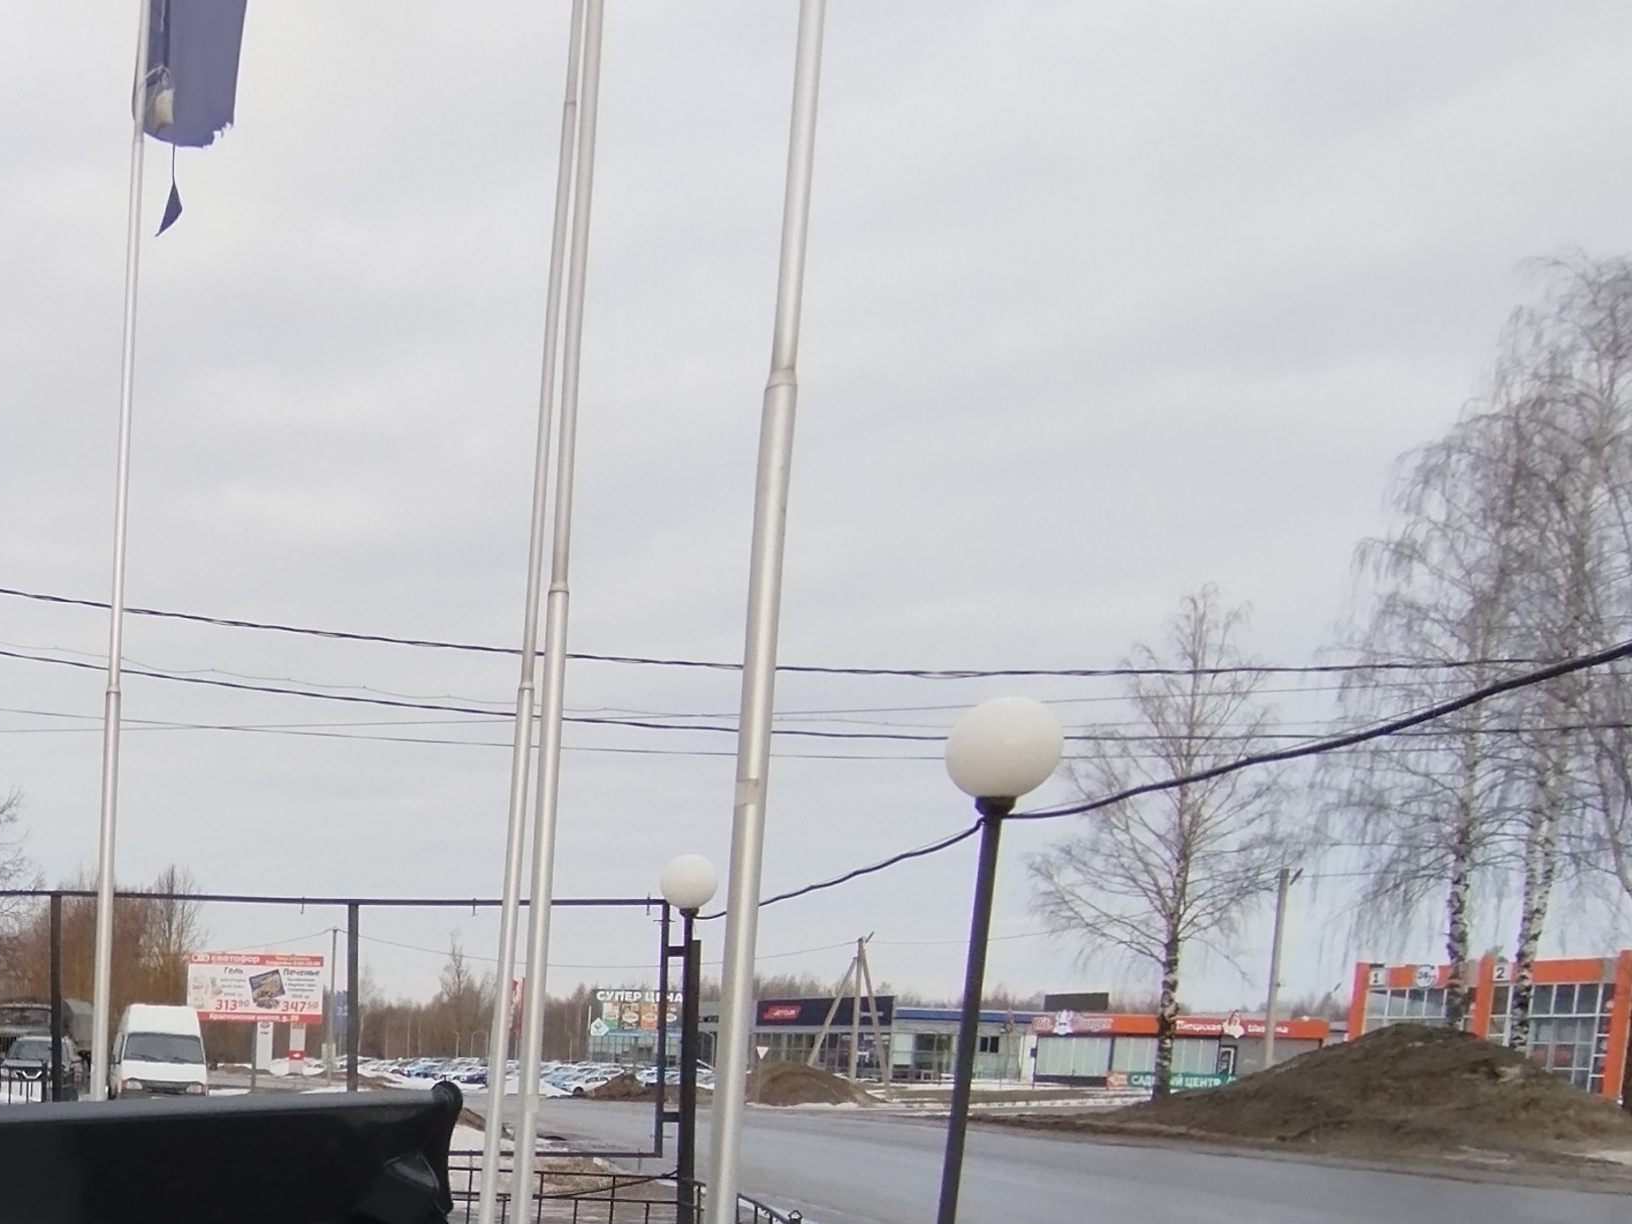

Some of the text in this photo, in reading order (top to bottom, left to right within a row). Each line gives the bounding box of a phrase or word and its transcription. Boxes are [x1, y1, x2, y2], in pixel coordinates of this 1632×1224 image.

[1496, 967, 1505, 979] 2
[596, 990, 642, 1002] СУПЕР
[1185, 1077, 1221, 1087] ЦЕНТР
